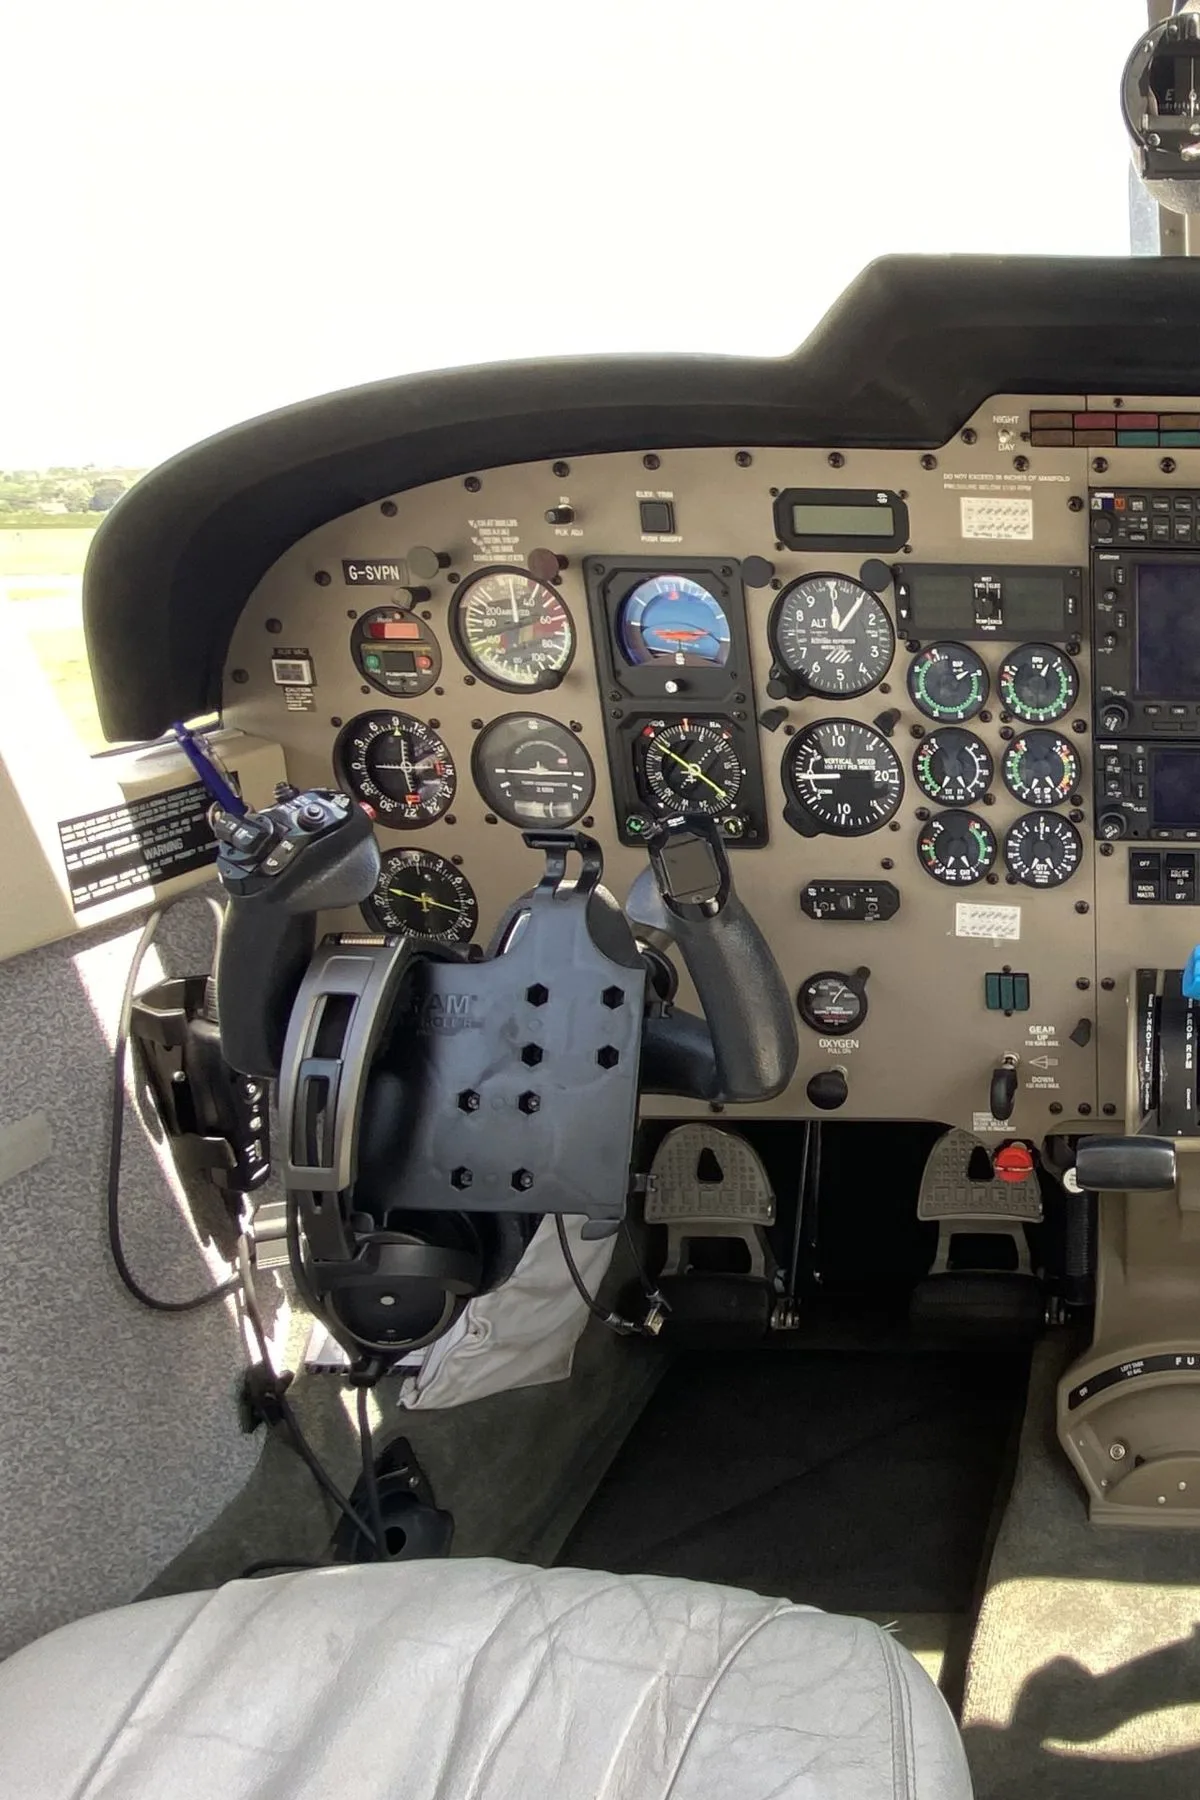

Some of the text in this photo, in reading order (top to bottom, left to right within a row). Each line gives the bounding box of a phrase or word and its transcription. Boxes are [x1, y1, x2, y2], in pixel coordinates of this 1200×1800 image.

[993, 416, 1020, 424] NIGHT
[349, 566, 400, 581] G-SVPN
[806, 596, 816, 608] 9
[540, 616, 552, 624] 60
[796, 610, 804, 622] 8
[868, 614, 876, 626] 2
[811, 618, 828, 628] ALT
[542, 640, 553, 648] 80
[532, 653, 546, 661] 100
[800, 648, 808, 658] 7
[870, 646, 880, 658] 3
[812, 662, 820, 673] 6
[859, 662, 867, 674] 4
[836, 669, 845, 680] 5
[392, 716, 400, 726] 9
[369, 722, 378, 732] 6
[413, 722, 427, 735] 12
[354, 739, 364, 748] 3
[832, 736, 846, 747] 10
[874, 770, 890, 782] 20
[360, 782, 374, 795] 33
[380, 799, 394, 812] 30
[838, 803, 852, 814] 10
[404, 808, 418, 818] 27
[143, 837, 184, 861] WARNING
[412, 853, 420, 862] 0
[388, 858, 401, 870] 33
[374, 894, 386, 906] 27
[1029, 1026, 1055, 1034] GEAR
[819, 1039, 859, 1048] OXYGEN
[934, 1186, 1038, 1202] PIPER
